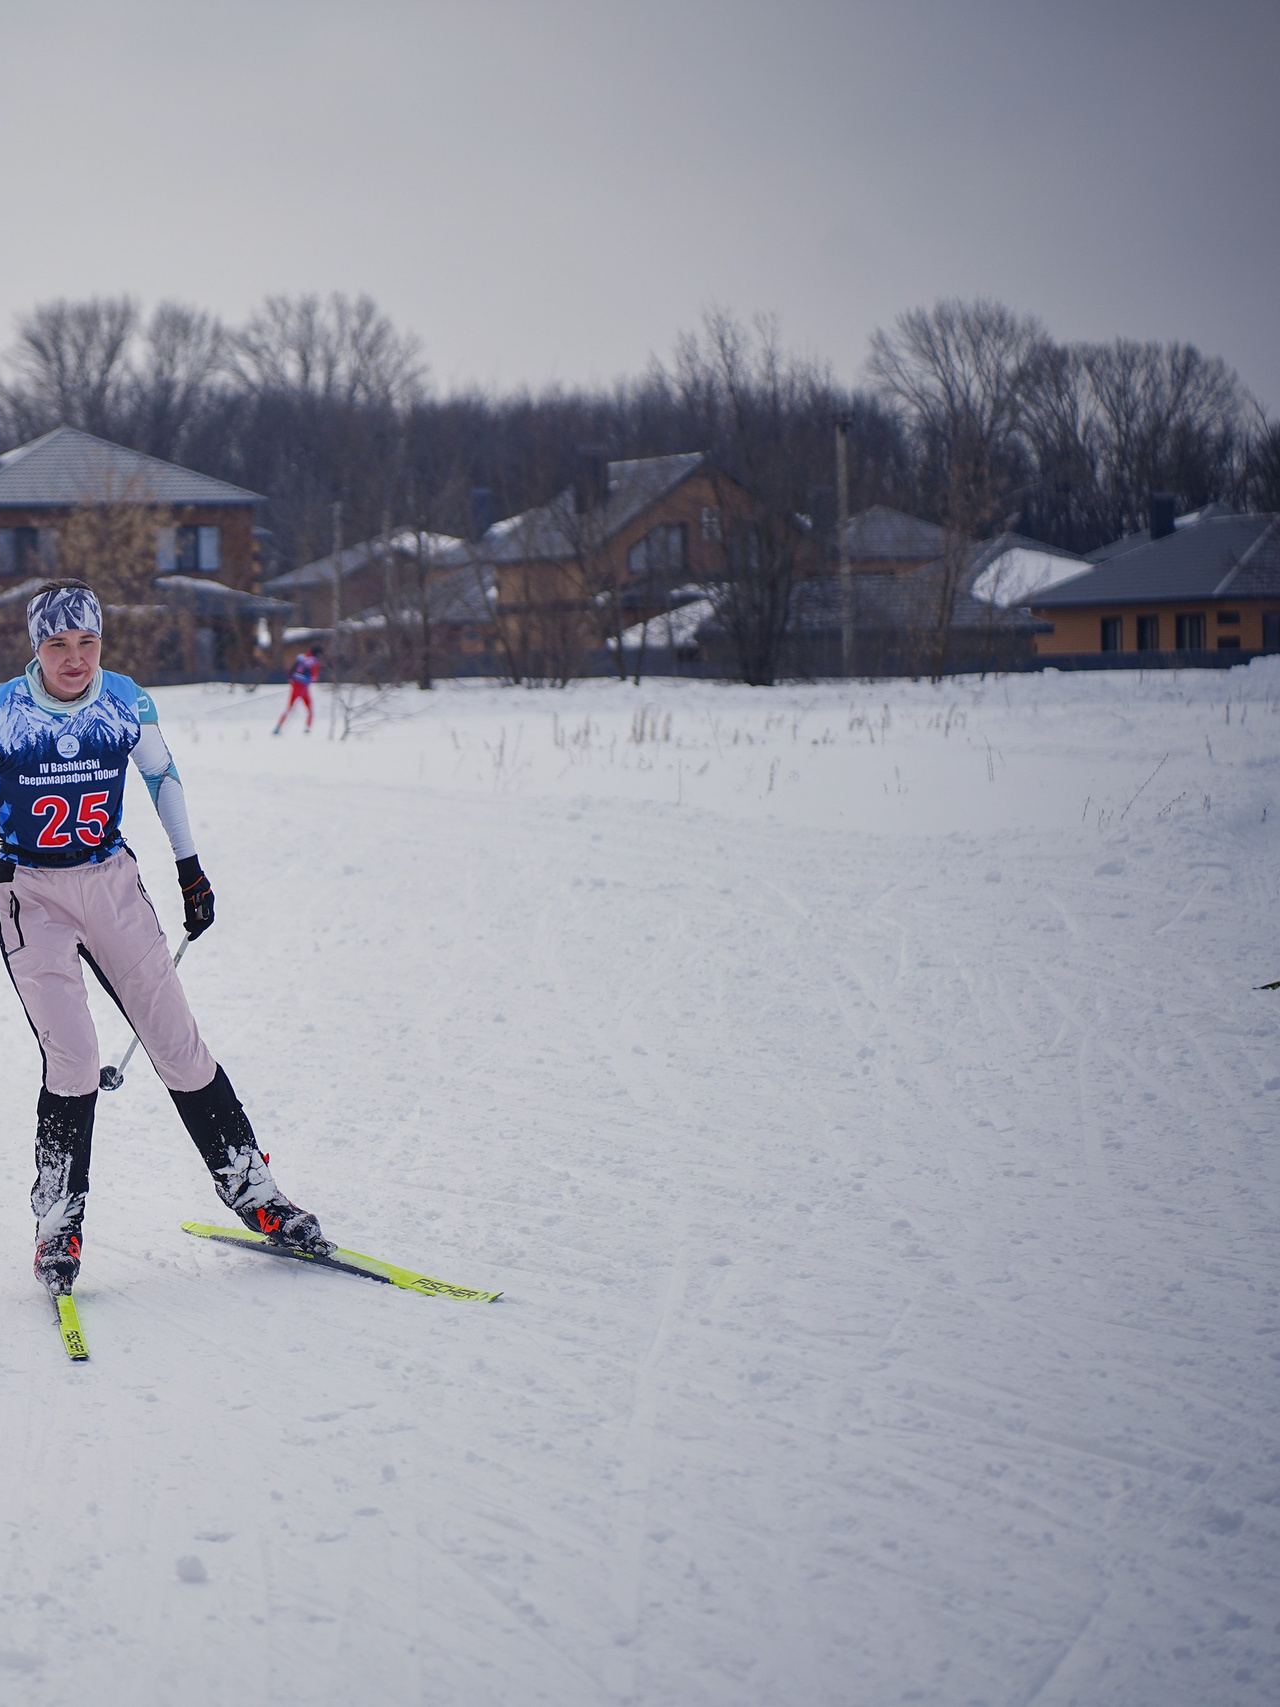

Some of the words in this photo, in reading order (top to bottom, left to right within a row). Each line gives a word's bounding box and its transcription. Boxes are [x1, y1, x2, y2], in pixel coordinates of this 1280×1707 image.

[39, 763, 49, 774] IV
[51, 759, 100, 773] BashkirSki
[18, 773, 92, 786] Сверхмарафон
[93, 768, 119, 781] 100км
[31, 790, 110, 848] 25
[411, 1278, 478, 1299] FISCHER
